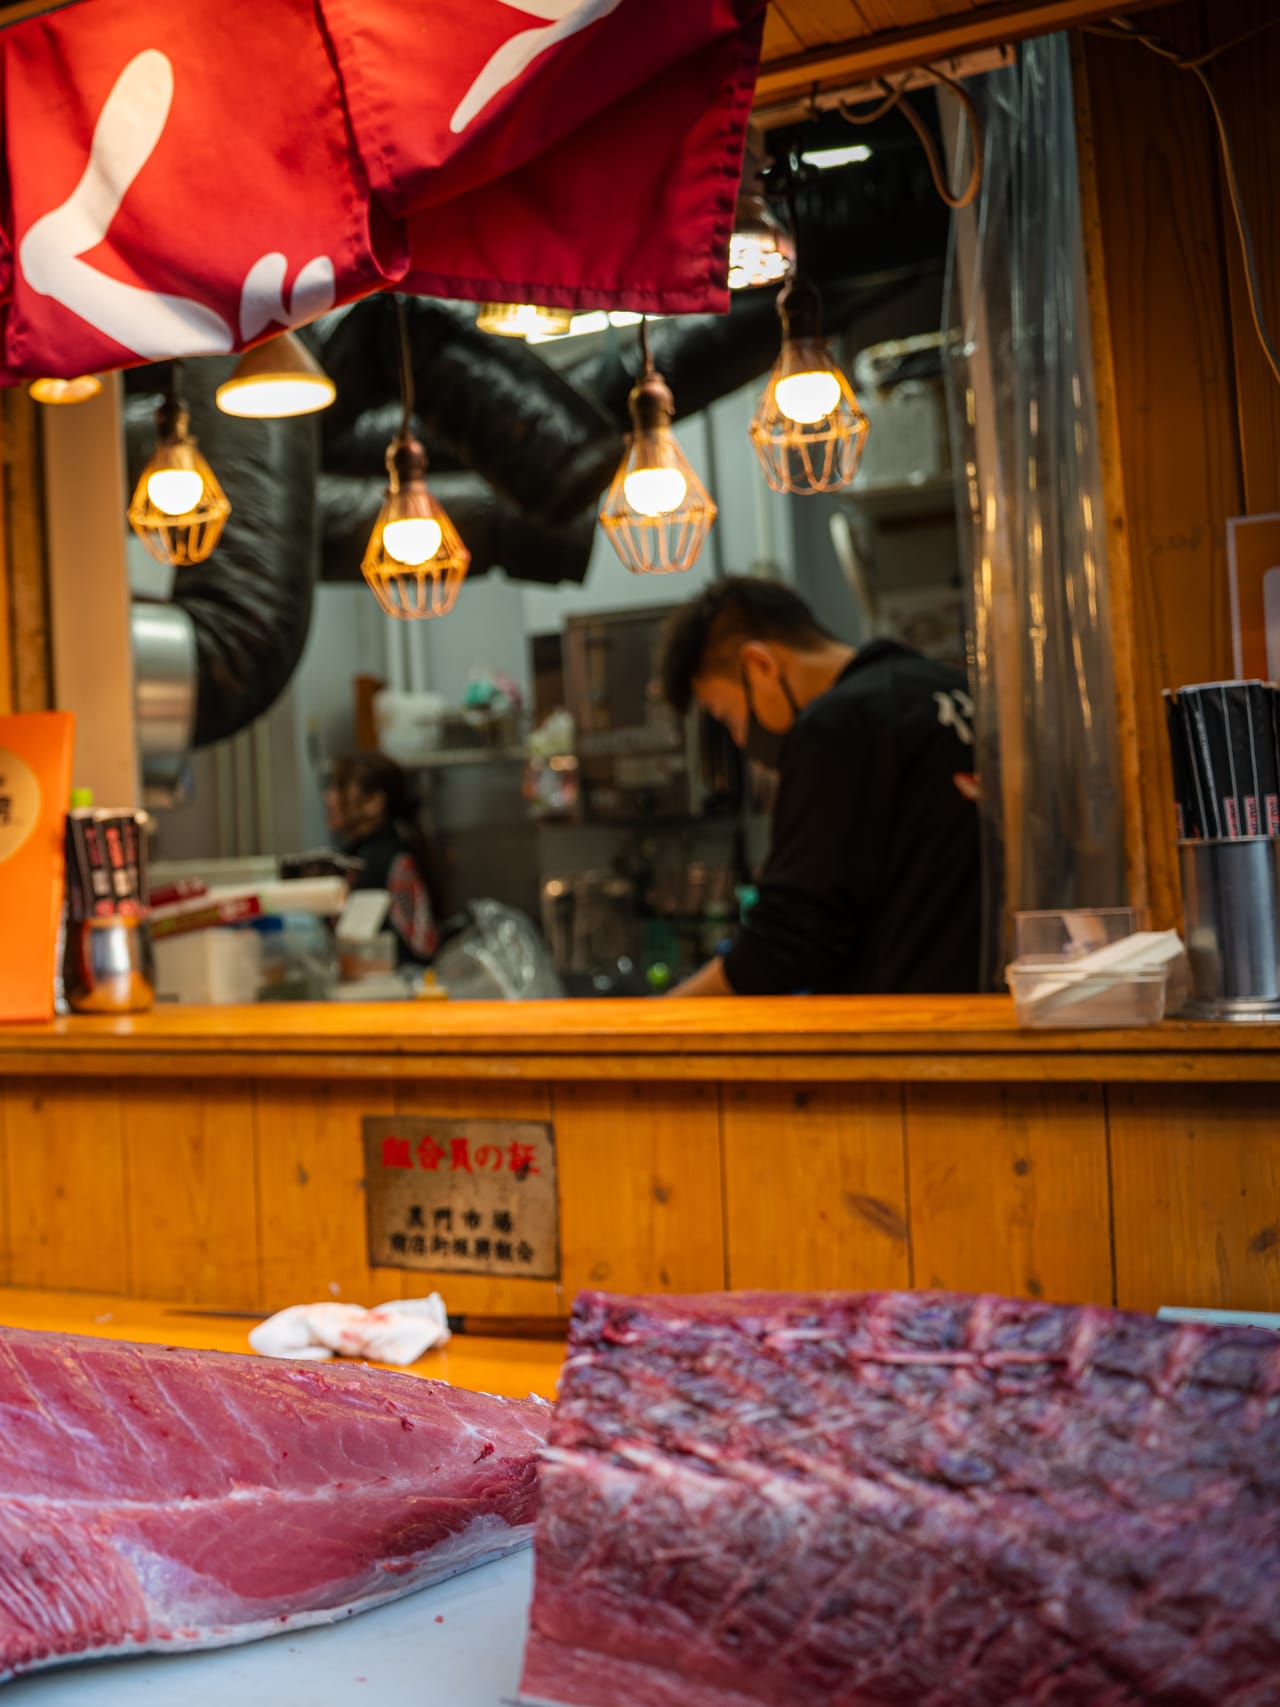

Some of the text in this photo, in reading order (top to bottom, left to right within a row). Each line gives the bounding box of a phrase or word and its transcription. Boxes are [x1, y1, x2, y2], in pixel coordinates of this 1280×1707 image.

[382, 1136, 540, 1174] 組合員の証
